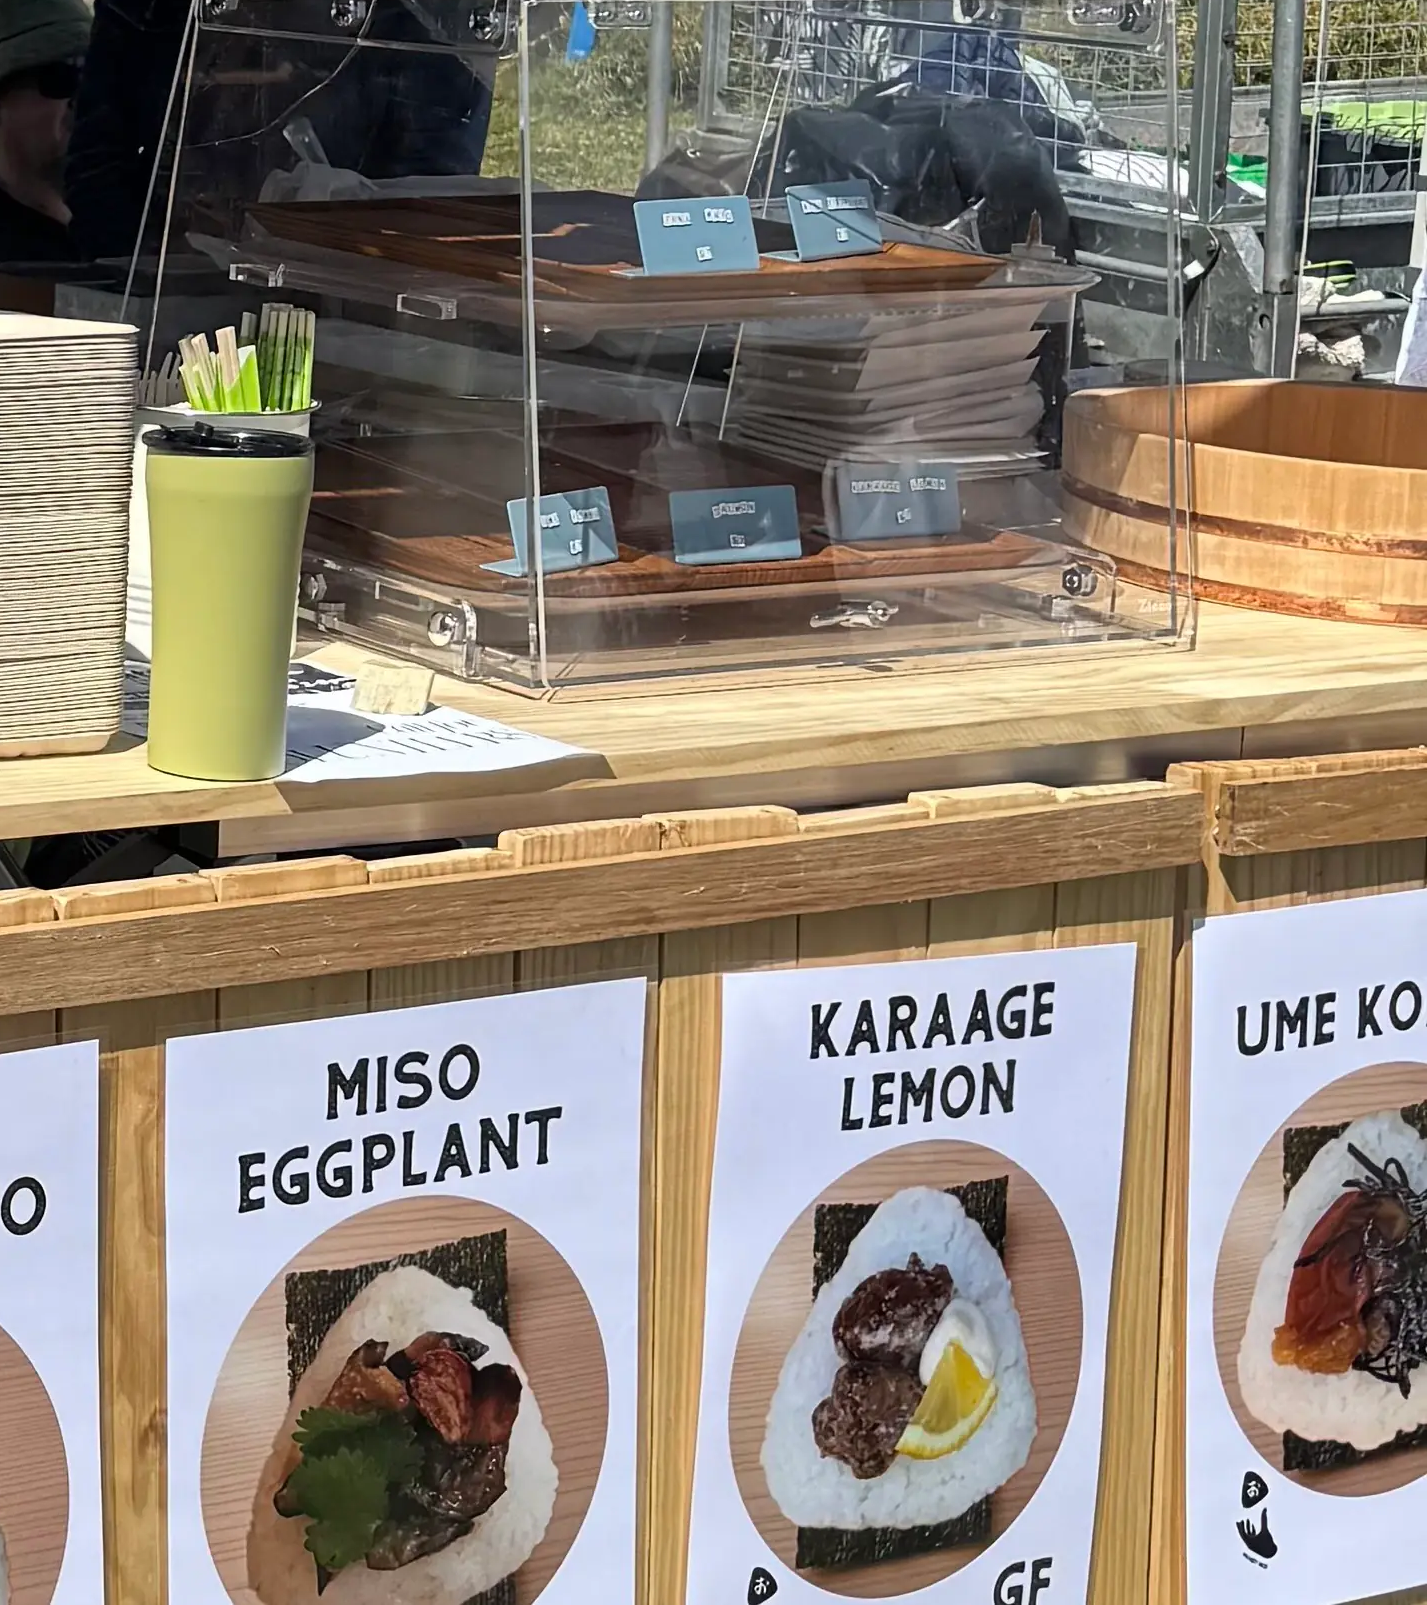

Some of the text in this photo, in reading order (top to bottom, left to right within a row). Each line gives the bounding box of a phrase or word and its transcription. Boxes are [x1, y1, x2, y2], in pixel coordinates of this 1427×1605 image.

[810, 982, 1055, 1059] KARAAGE
[1237, 981, 1427, 1056] UME KO
[326, 1044, 480, 1121] MISO
[841, 1060, 1017, 1131] LEMON
[238, 1106, 563, 1214] EGGPLANT
[993, 1557, 1053, 1605] GF
